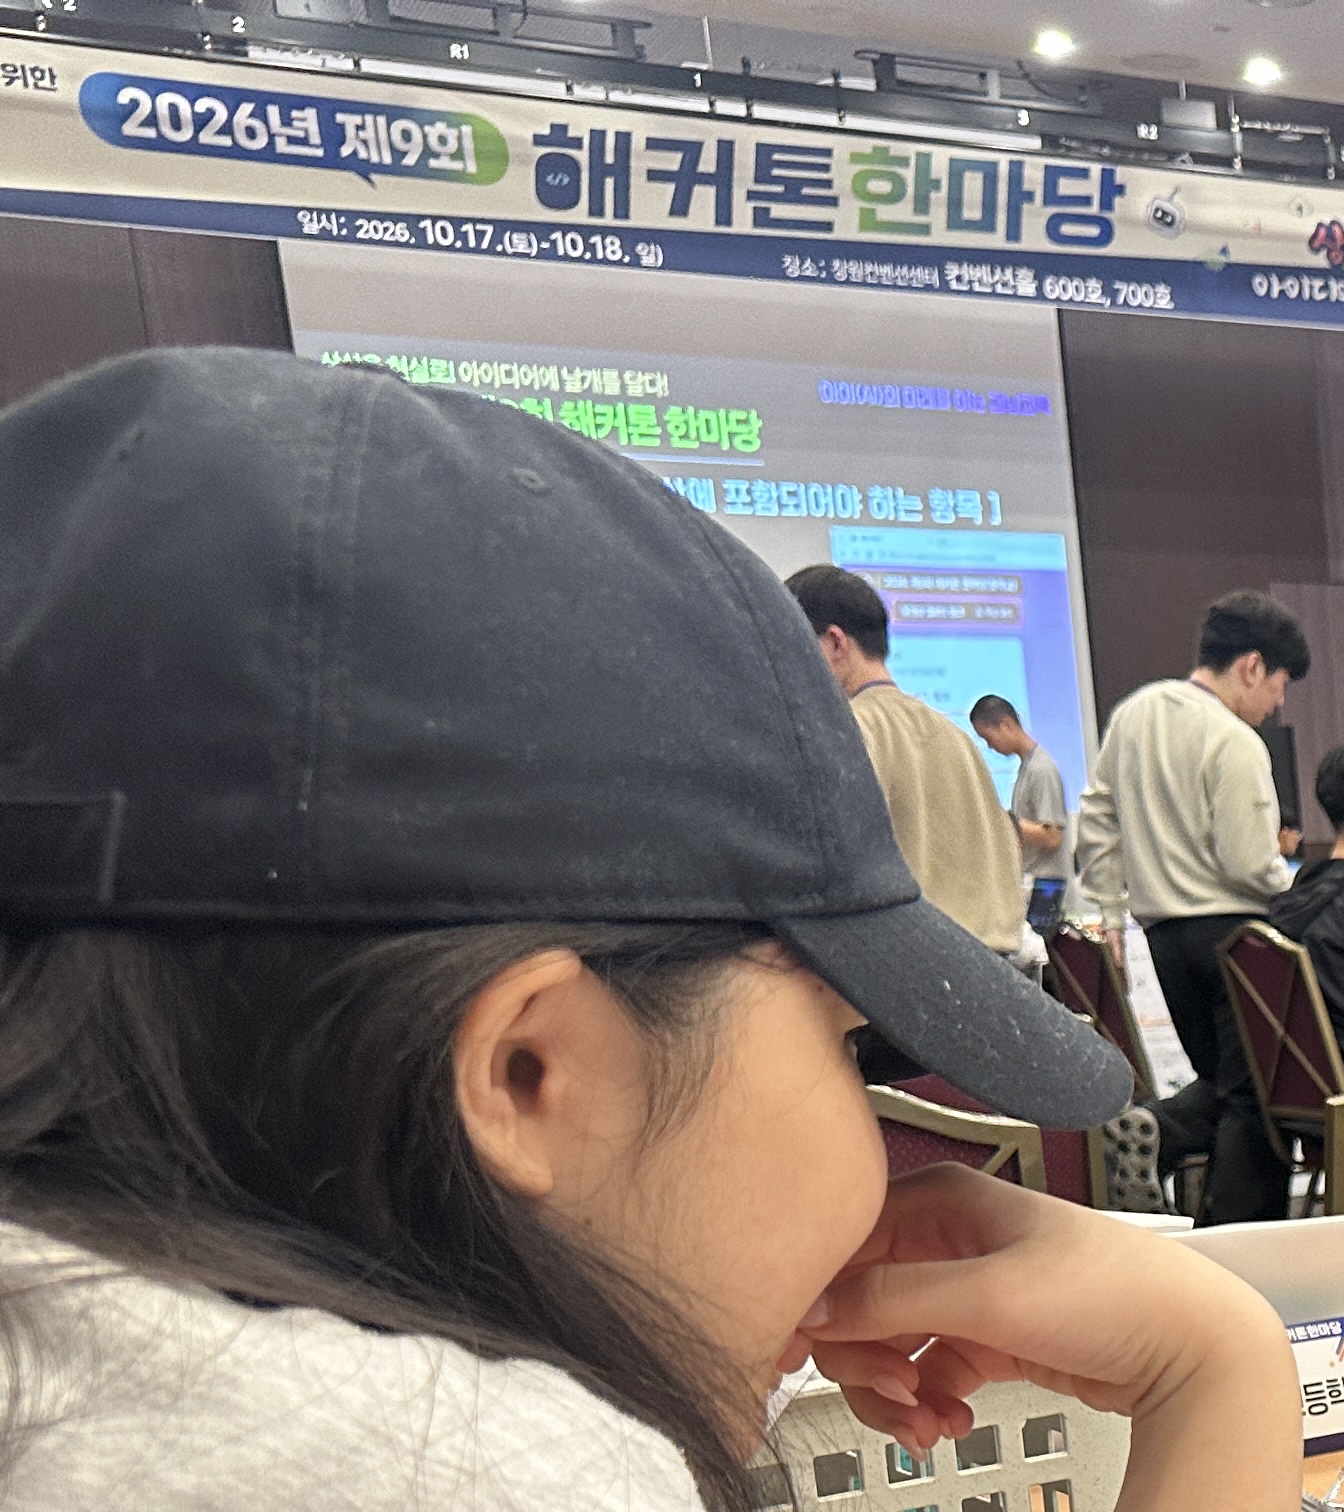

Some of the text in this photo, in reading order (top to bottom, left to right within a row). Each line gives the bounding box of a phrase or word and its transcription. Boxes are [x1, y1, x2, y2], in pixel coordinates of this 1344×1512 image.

[232, 17, 246, 33] 2
[0, 62, 57, 92] 위한
[117, 86, 479, 174] 2026년 제9회
[297, 210, 348, 236] 일시:
[944, 260, 1038, 298] 컨벤션홀
[1115, 280, 1176, 310] 700호
[458, 360, 560, 393] 아이디어에
[561, 365, 622, 395] 날개를
[559, 398, 661, 448] 해커톤
[665, 404, 764, 453] 한마당
[722, 478, 863, 520] 포함되어야
[867, 484, 924, 523] 하는
[928, 487, 984, 525] 항목
[1285, 1320, 1343, 1342] 커톤한마당
